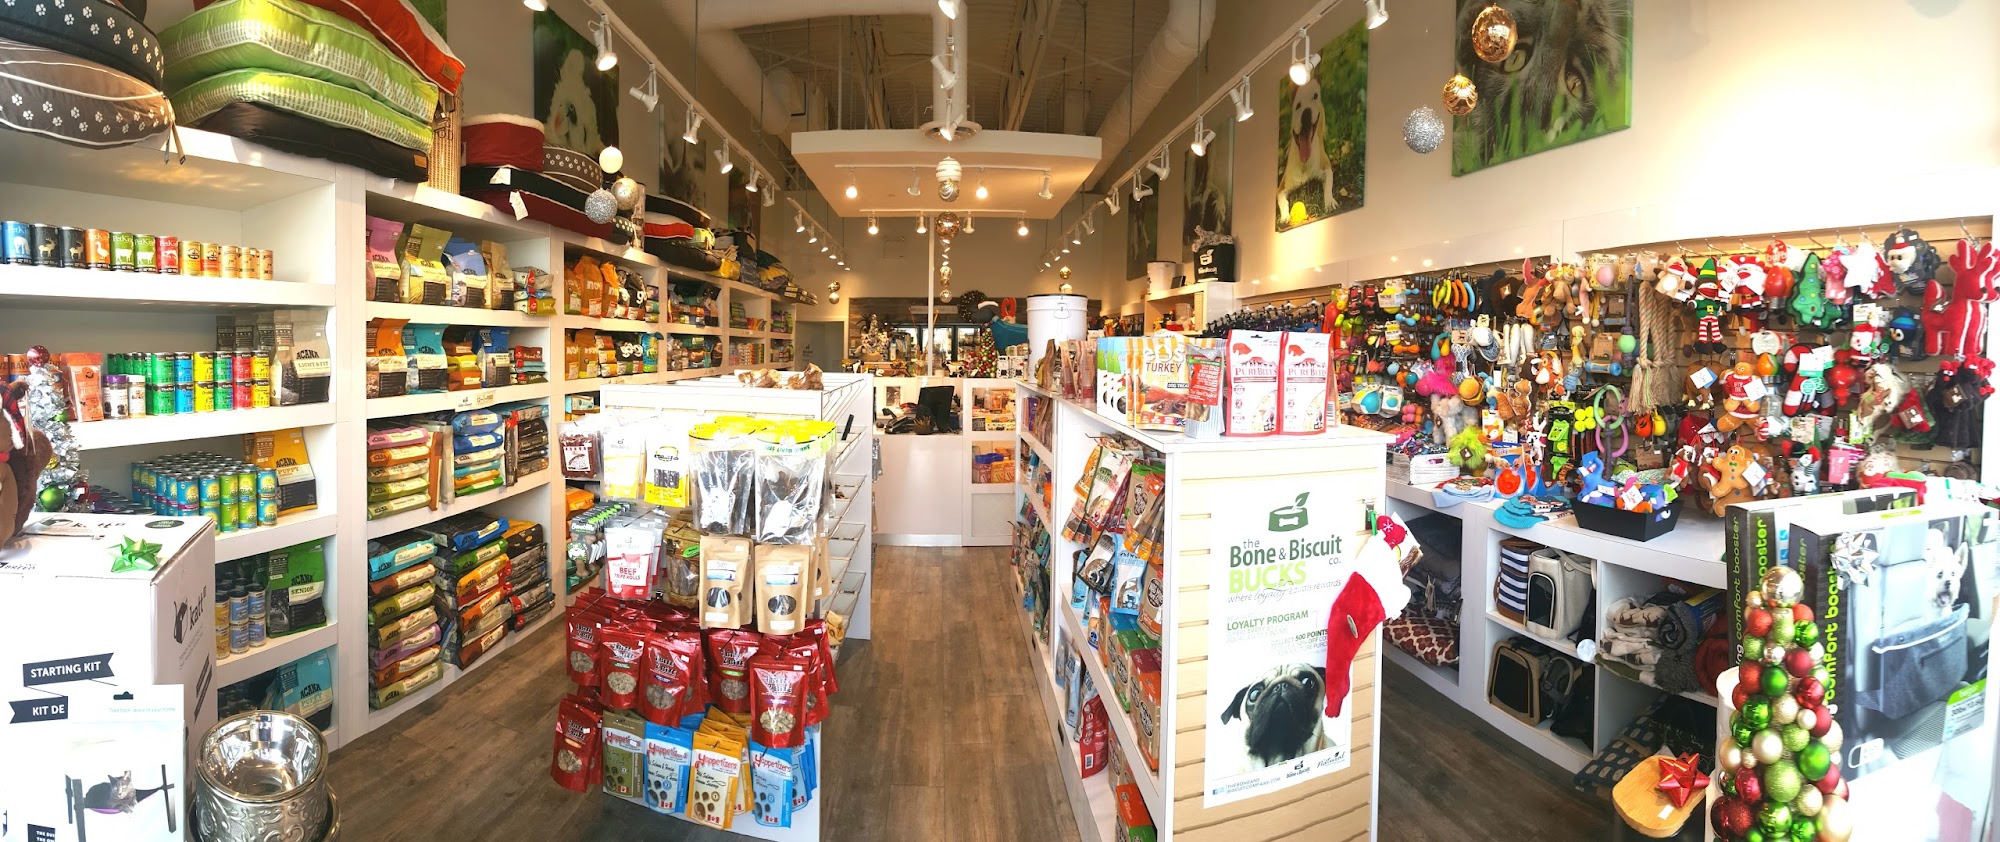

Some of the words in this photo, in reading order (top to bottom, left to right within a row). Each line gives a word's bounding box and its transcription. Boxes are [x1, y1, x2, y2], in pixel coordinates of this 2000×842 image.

[296, 350, 320, 360] ACANA
[1146, 362, 1182, 373] TURKEY
[276, 457, 297, 468] ACANA
[278, 466, 299, 474] PUPPY
[1243, 538, 1260, 549] the
[1230, 545, 1276, 568] Bone
[1279, 548, 1286, 560] &
[1289, 534, 1342, 561] Biscuit
[620, 567, 636, 575] BEEF
[1229, 560, 1306, 594] BUCKS
[291, 573, 313, 586] ACANA
[291, 586, 314, 594] SENIOR
[1228, 594, 1252, 603] where
[1314, 579, 1342, 590] rewards
[1734, 577, 1743, 640] comfort
[1227, 617, 1264, 630] LOYALTY
[1267, 610, 1309, 625] PROGRAM
[1307, 629, 1328, 638] POINTS
[30, 663, 81, 678] STARTING
[84, 661, 101, 672] KIT
[32, 706, 49, 716] KIT
[51, 704, 65, 714] DE
[695, 753, 737, 769] Yappetizers
[753, 754, 791, 772] Yappetizers
